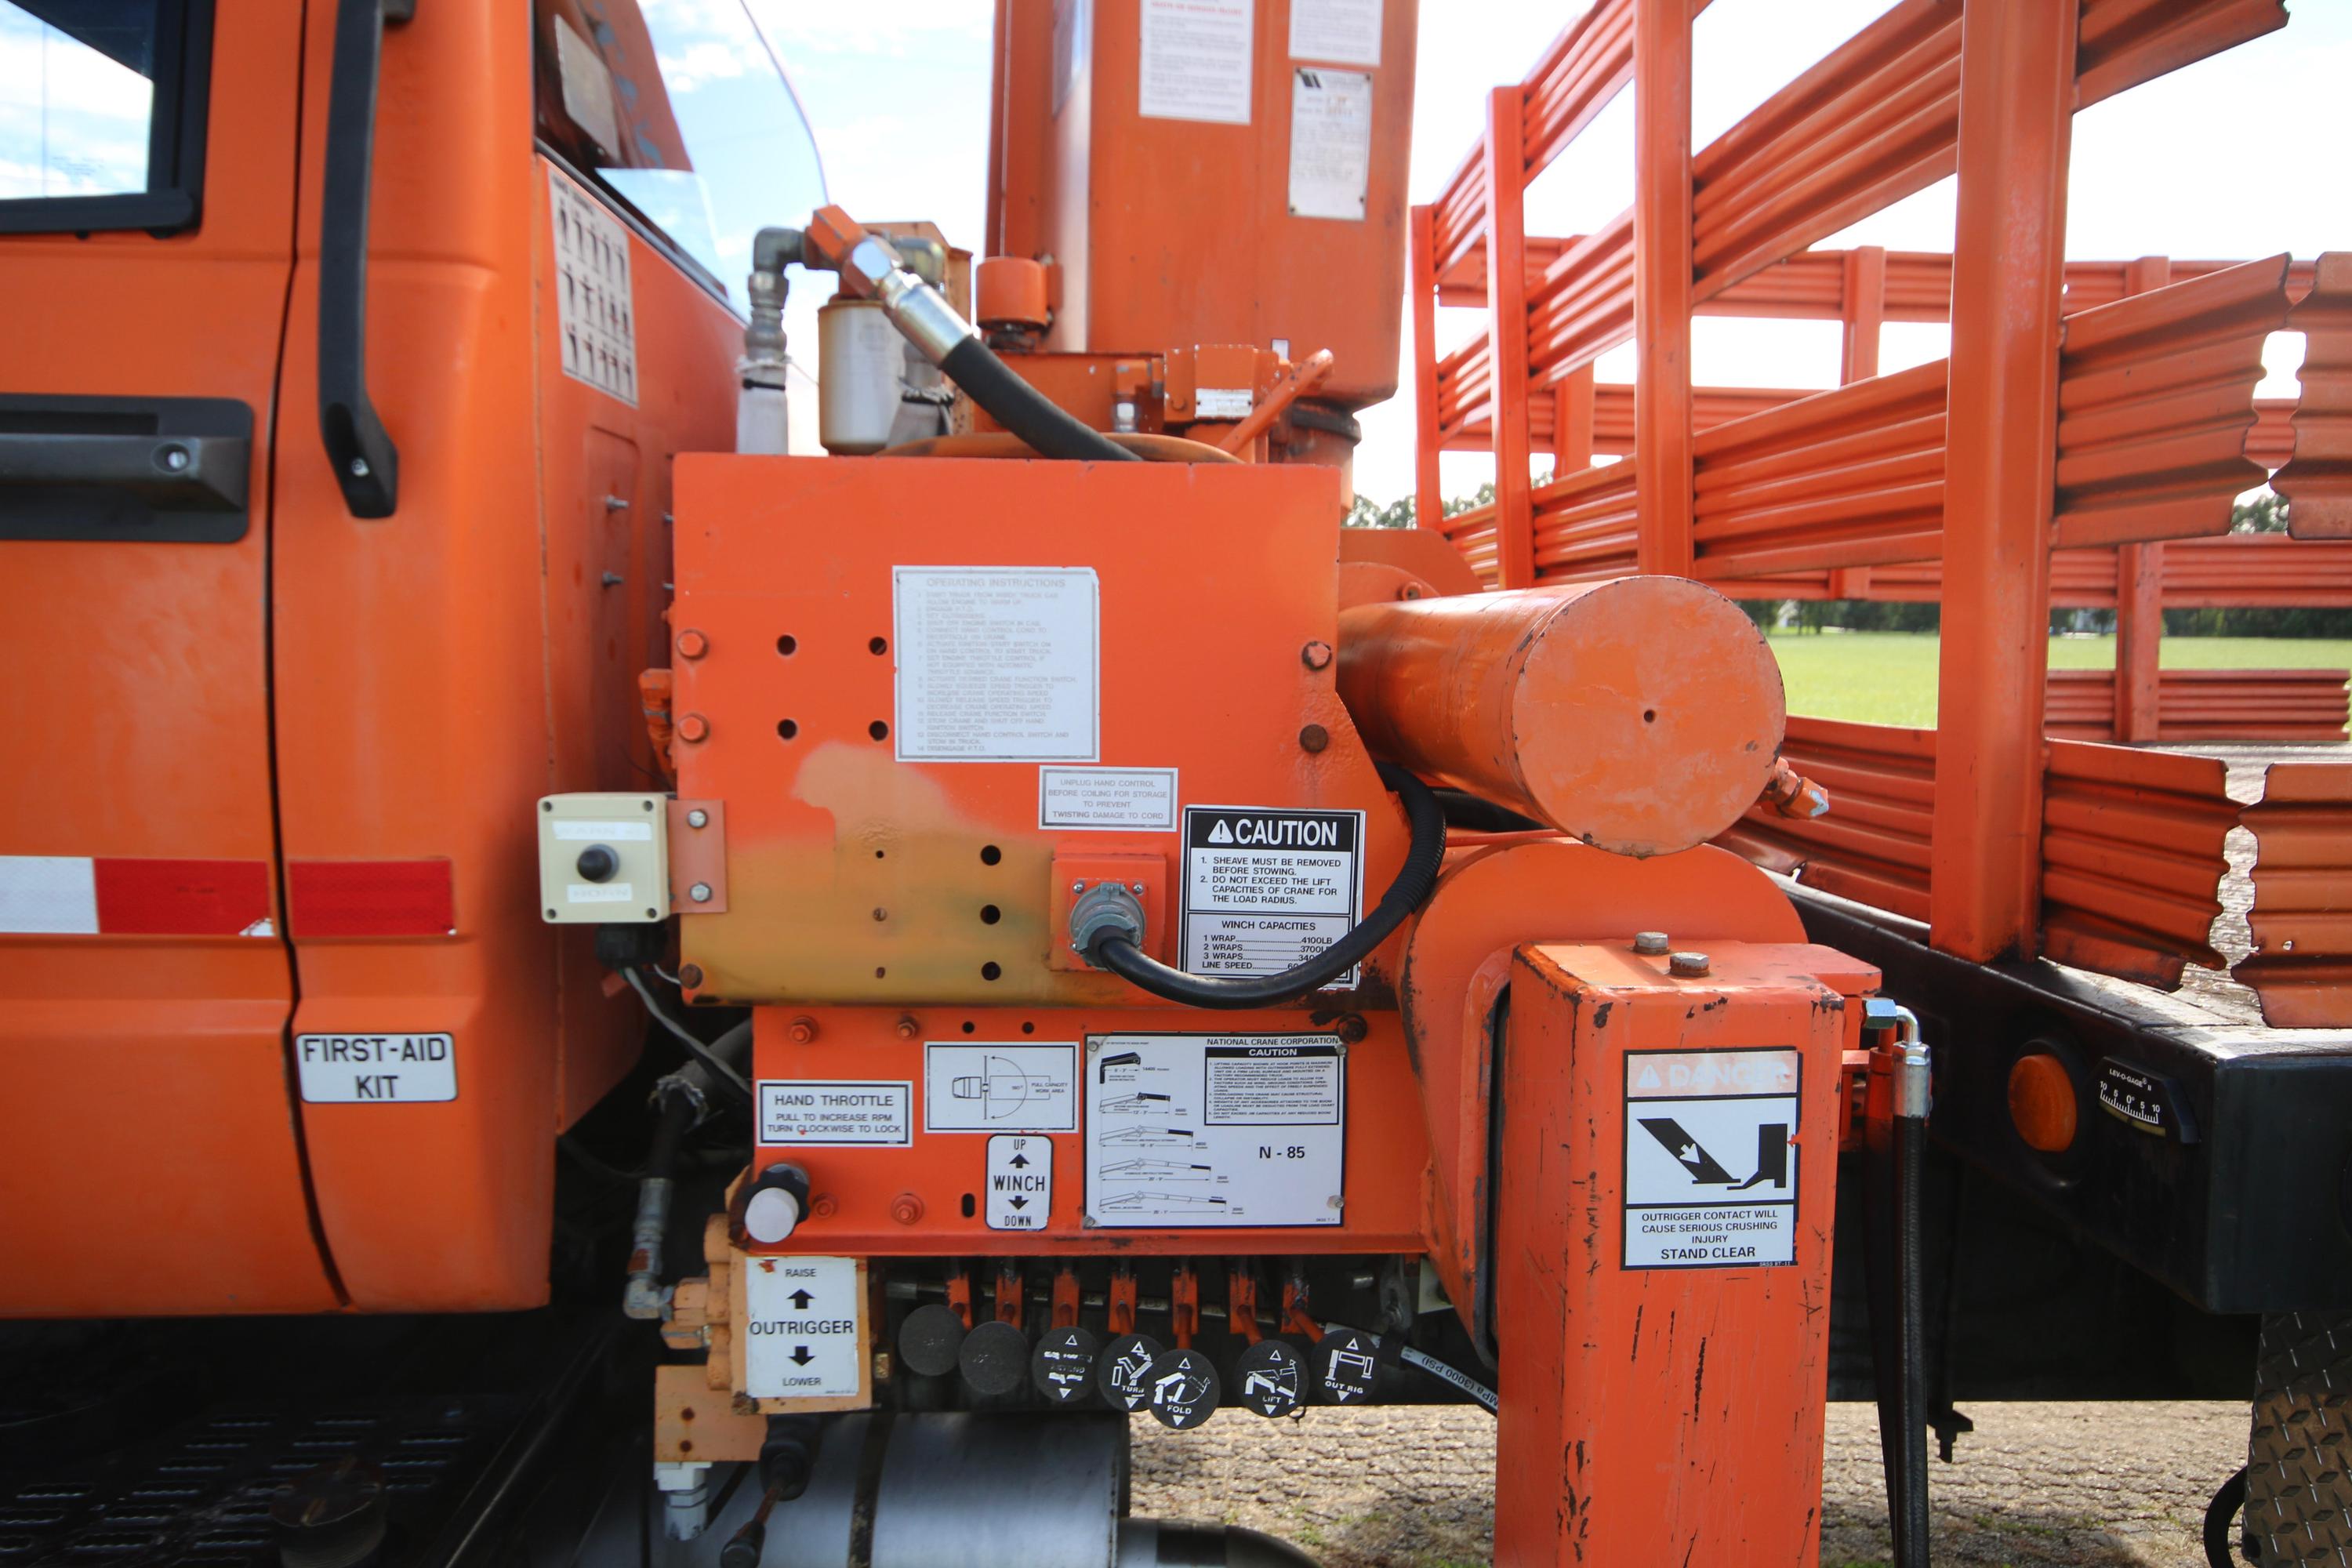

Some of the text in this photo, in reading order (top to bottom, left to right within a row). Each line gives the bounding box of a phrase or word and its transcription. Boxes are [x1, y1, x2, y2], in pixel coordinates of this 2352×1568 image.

[926, 577, 1066, 588] OPERATING INSTRUCTIONS
[1234, 818, 1337, 846] CAUTION
[1213, 856, 1248, 865] SHEAVE
[1251, 857, 1276, 866] MUST
[1297, 858, 1341, 867] REMOVED
[1212, 866, 1296, 876] BEFORE STOWING.
[1212, 875, 1226, 884] DO
[1212, 885, 1264, 894] CAPACITIES
[1268, 886, 1279, 895] OF
[1283, 887, 1315, 895] CRANE
[1261, 895, 1296, 904] RADIUS.
[1221, 920, 1316, 931] WINCH CAPACITIES
[1280, 1036, 1338, 1045] CORPORATION
[303, 1038, 446, 1062] FIRST-AID
[1669, 1062, 1791, 1087] DANGER
[355, 1075, 398, 1098] KIT
[2100, 1081, 2107, 1090] 10
[775, 1094, 893, 1106] HAND THROTTLE
[797, 1124, 855, 1133] CLOCKWISE
[858, 1124, 871, 1133] TO
[874, 1124, 901, 1133] LOCK
[1013, 1138, 1025, 1150] UP
[993, 1174, 1044, 1192] WINCH
[1004, 1215, 1031, 1227] DOWN
[1642, 1212, 1700, 1221] OUTRIGGER
[1703, 1210, 1751, 1220] CONTACT
[1642, 1221, 1777, 1233] CAUSE SERIOUS CRUSHING
[1692, 1235, 1728, 1243] INJURY
[1661, 1247, 1755, 1259] STAND CLEAR
[785, 1269, 816, 1277] RAISE
[750, 1320, 853, 1334] OUTRIGGER
[1421, 1356, 1444, 1372] PSI)
[782, 1377, 822, 1386] LOWER
[1325, 1381, 1363, 1394] OUT RIG
[1167, 1405, 1192, 1414] FOLD
